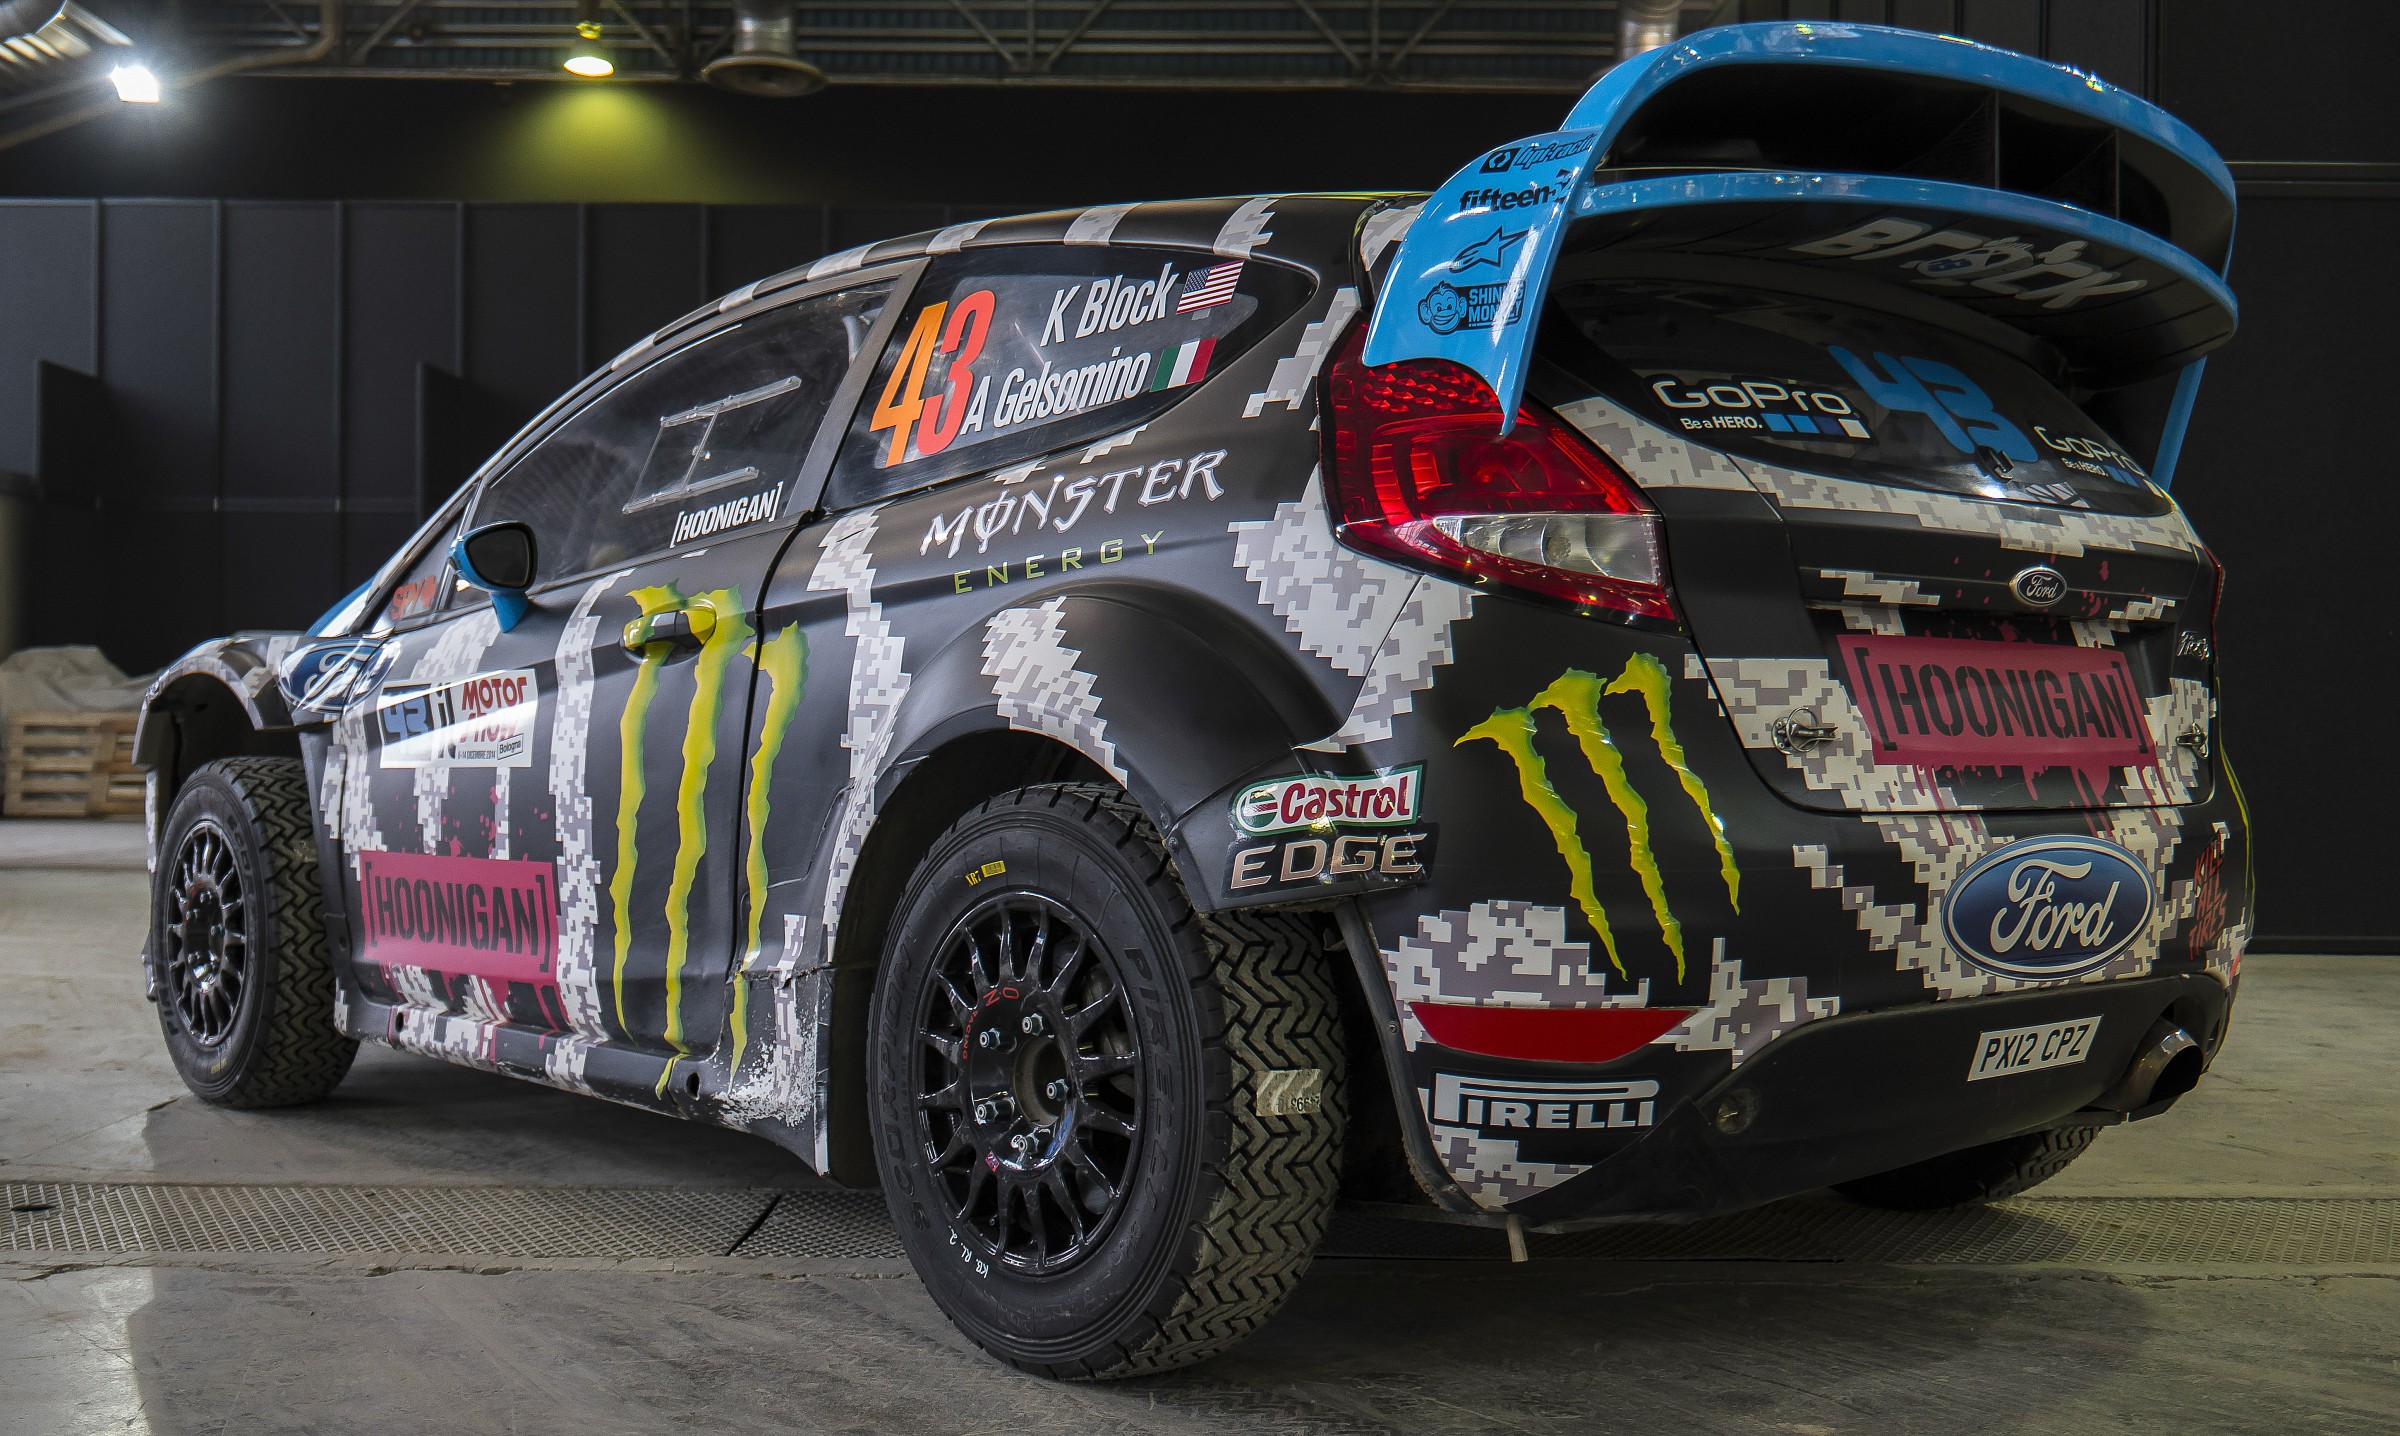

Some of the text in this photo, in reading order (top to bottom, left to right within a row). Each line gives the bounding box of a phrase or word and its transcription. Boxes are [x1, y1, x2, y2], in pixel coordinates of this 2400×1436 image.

[1040, 262, 1180, 347] K Block
[1469, 280, 1524, 305] SHING
[1469, 301, 1521, 323] MONEY
[869, 289, 995, 467] 43
[960, 347, 1152, 436] A Gelsomino
[1652, 380, 1853, 415] GoPro
[1827, 345, 2039, 463] 43
[1680, 417, 1764, 430] Be a HERO.
[2033, 425, 2146, 477] GoPro
[669, 480, 785, 549] [HOONIGAN]
[955, 530, 1164, 595] ENERGY
[2026, 575, 2059, 599] Ford
[1853, 646, 2150, 755] [HOONIGAN]
[499, 739, 522, 755] Bologna
[1281, 775, 1410, 825] Castrol
[1230, 832, 1428, 889] EDGE
[365, 861, 549, 974] [HOONIGAN]
[1990, 859, 2120, 953] Ford
[1979, 1023, 2091, 1073] PX12 CPZ
[1434, 1072, 1660, 1129] PIRELLI
